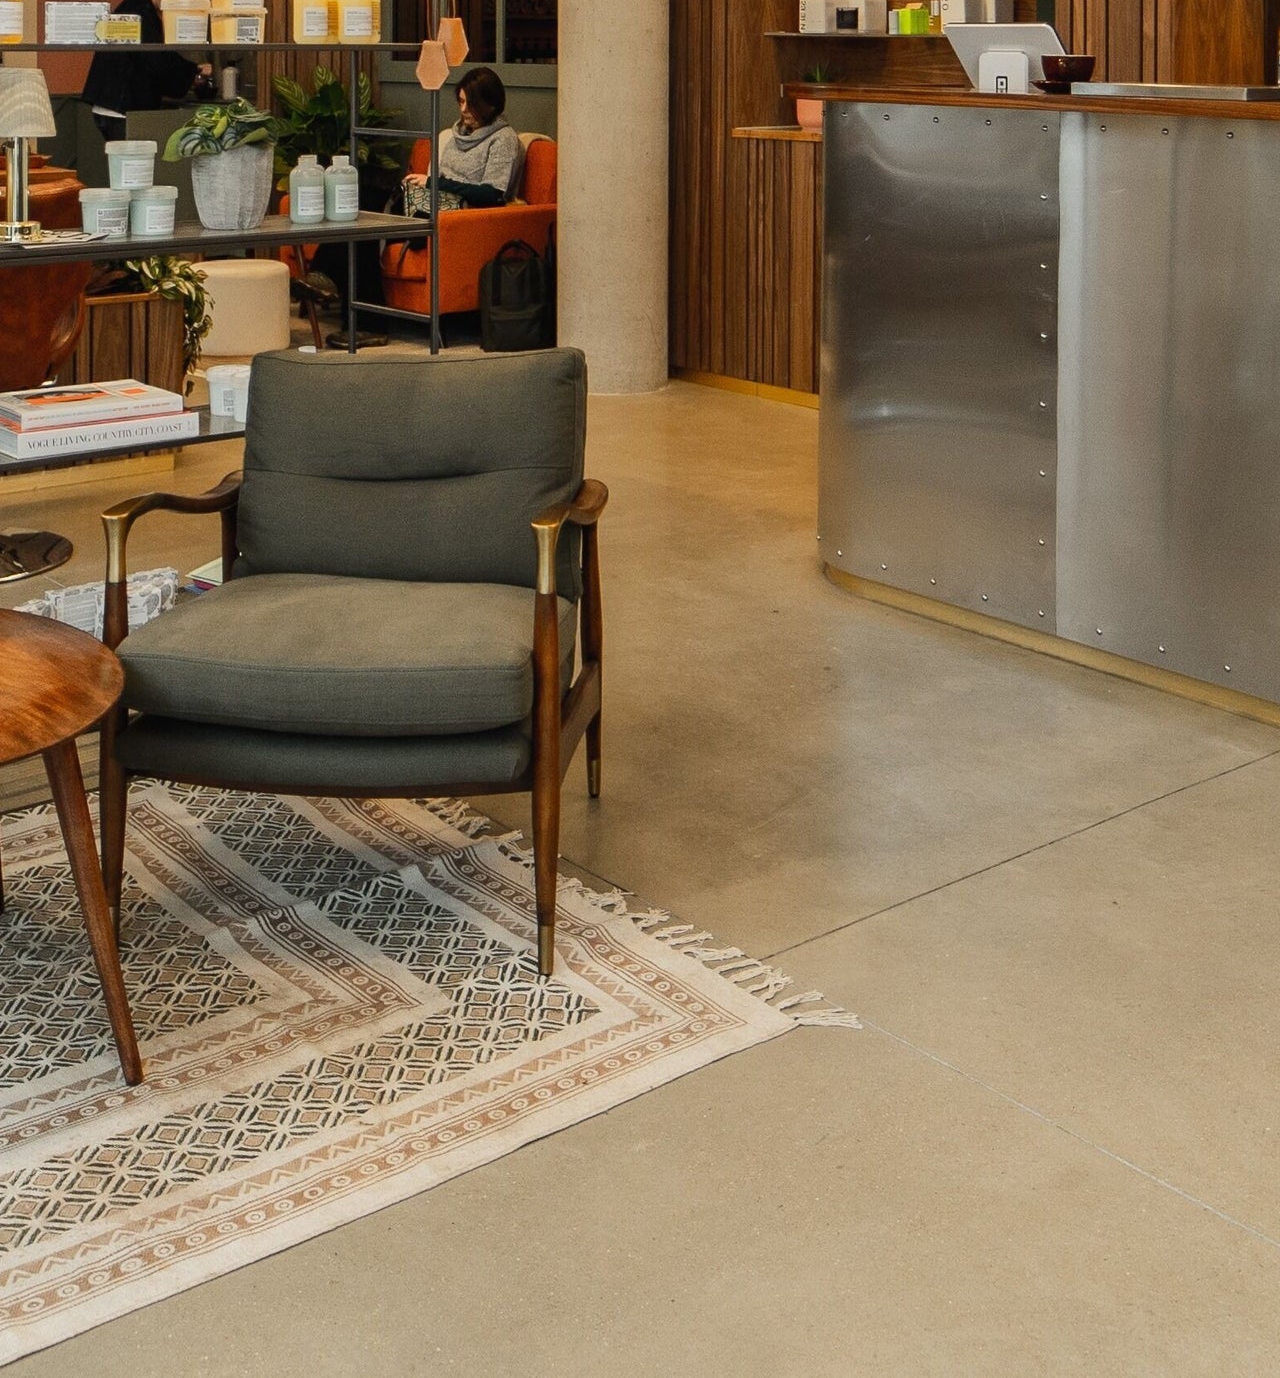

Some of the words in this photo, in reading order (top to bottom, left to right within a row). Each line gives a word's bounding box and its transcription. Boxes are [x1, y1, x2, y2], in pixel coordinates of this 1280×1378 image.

[27, 437, 58, 450] VOGUE
[59, 434, 91, 447] LIVING
[156, 423, 183, 435] COAST
